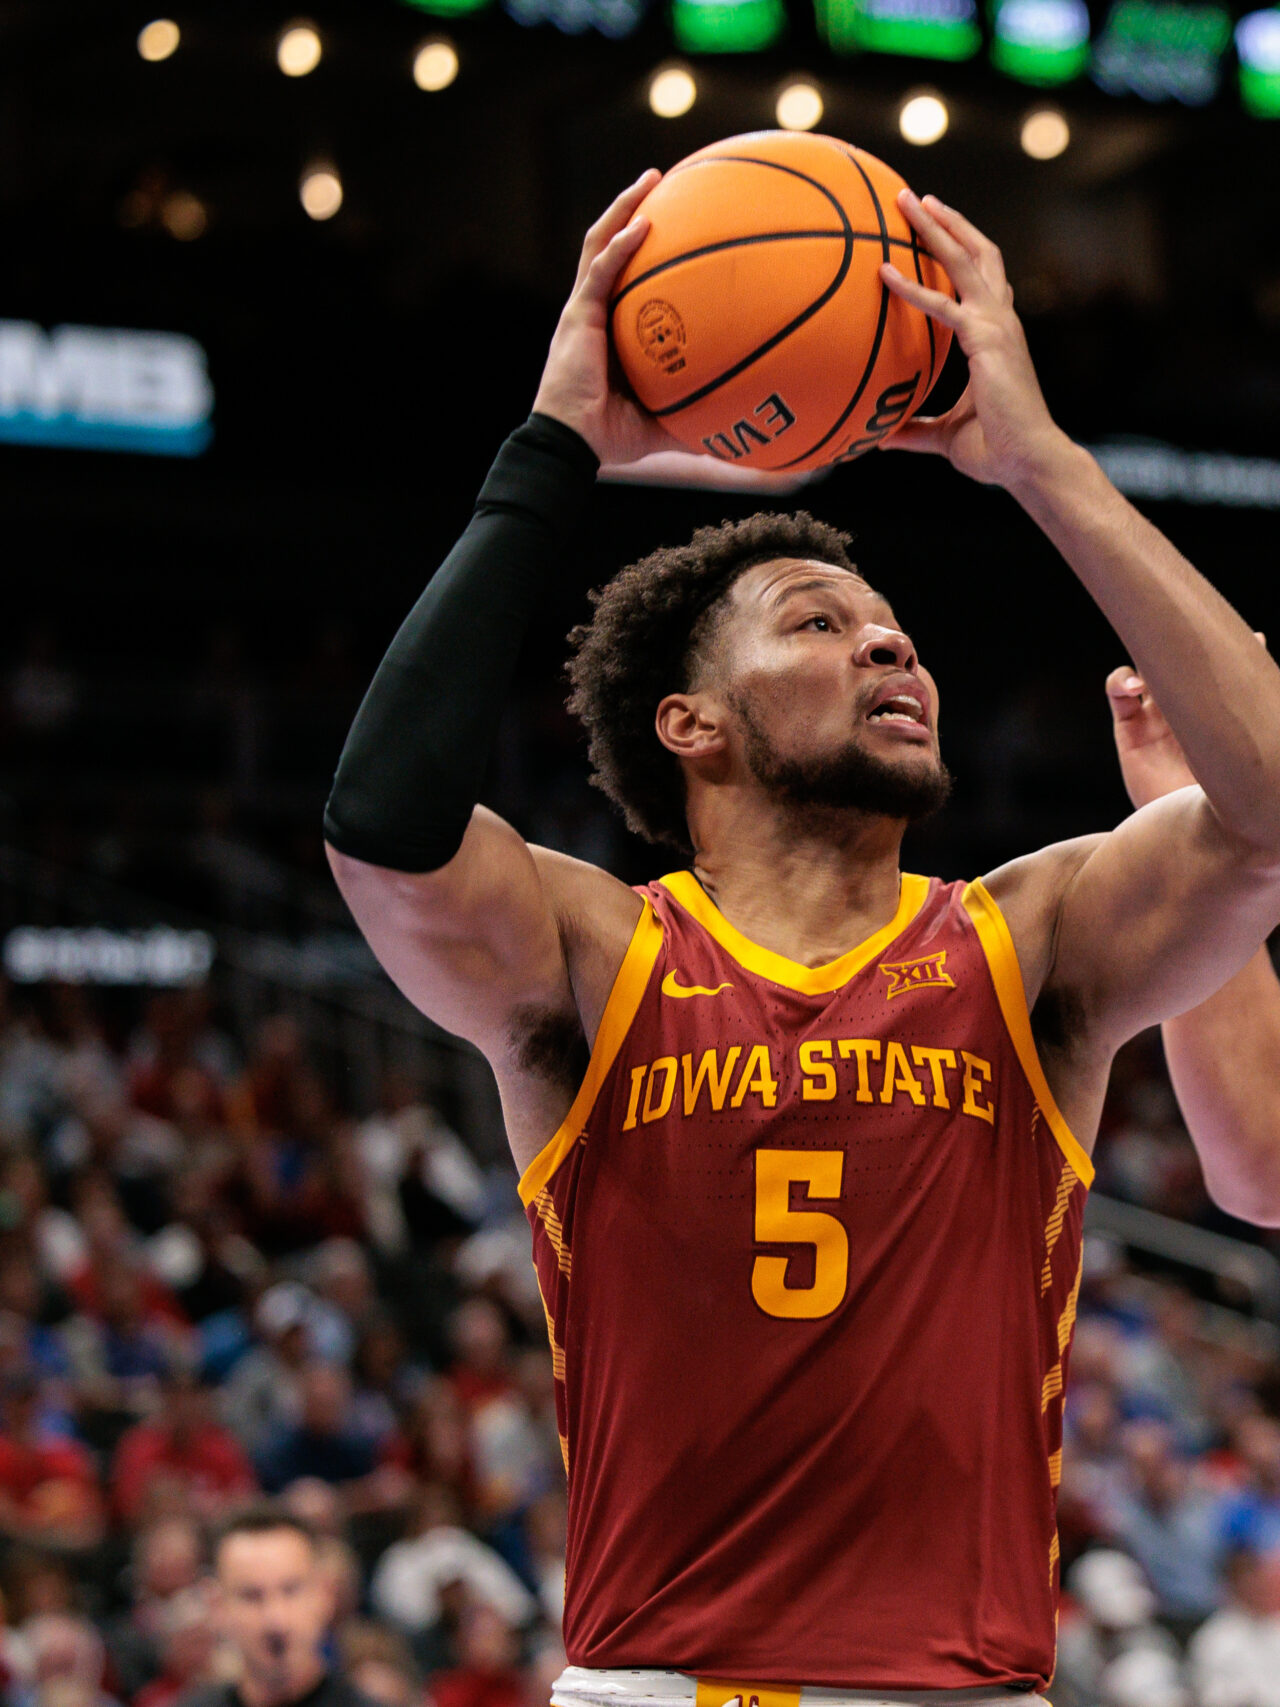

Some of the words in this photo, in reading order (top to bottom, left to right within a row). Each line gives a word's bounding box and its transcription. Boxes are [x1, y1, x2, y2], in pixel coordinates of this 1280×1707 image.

[622, 1044, 778, 1131] IOWA
[799, 1038, 995, 1126] STATE
[752, 1149, 849, 1319] 5
